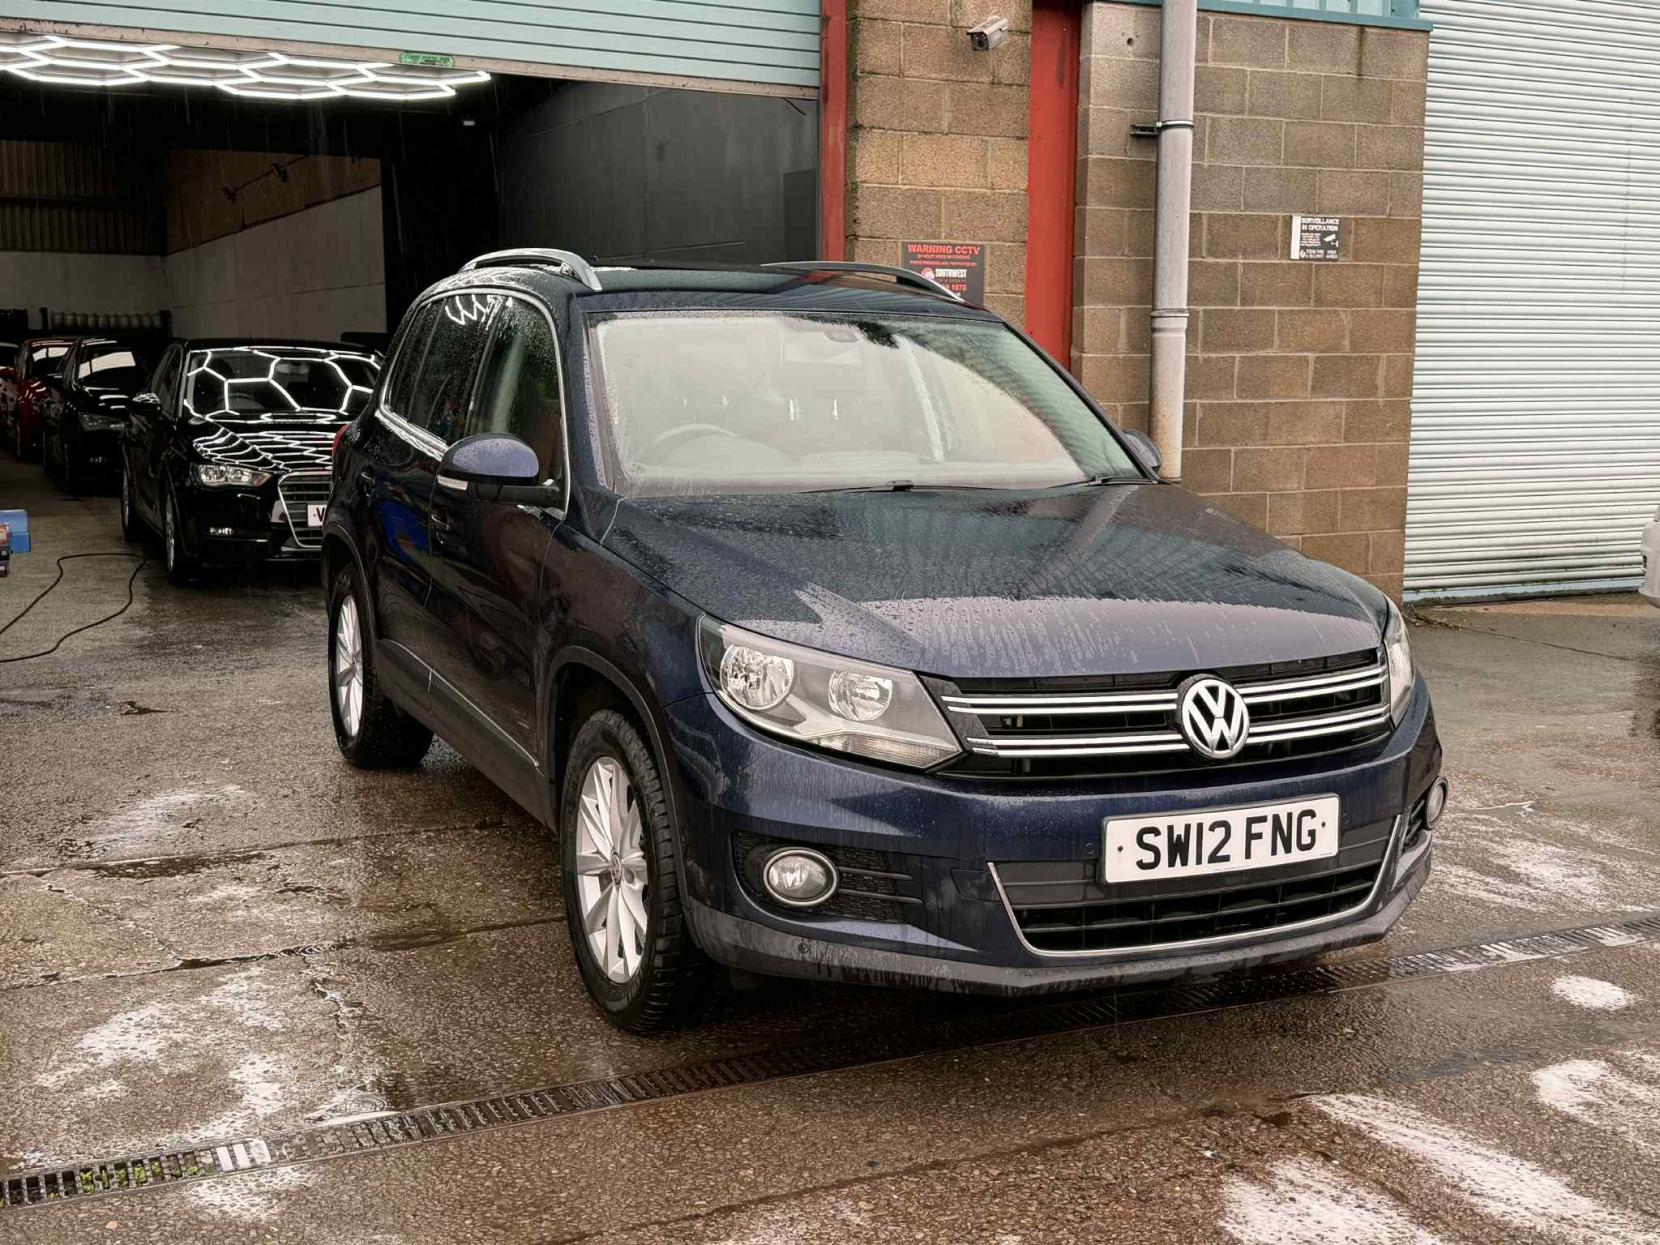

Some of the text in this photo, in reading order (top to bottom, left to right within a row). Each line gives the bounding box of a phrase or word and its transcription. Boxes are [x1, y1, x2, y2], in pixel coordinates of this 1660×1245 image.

[1301, 217, 1339, 225] SURVEILLANCE
[908, 244, 980, 256] WARNING CCTV
[935, 268, 967, 278] SOUTHWEST
[1135, 808, 1317, 871] SW12 FNG
